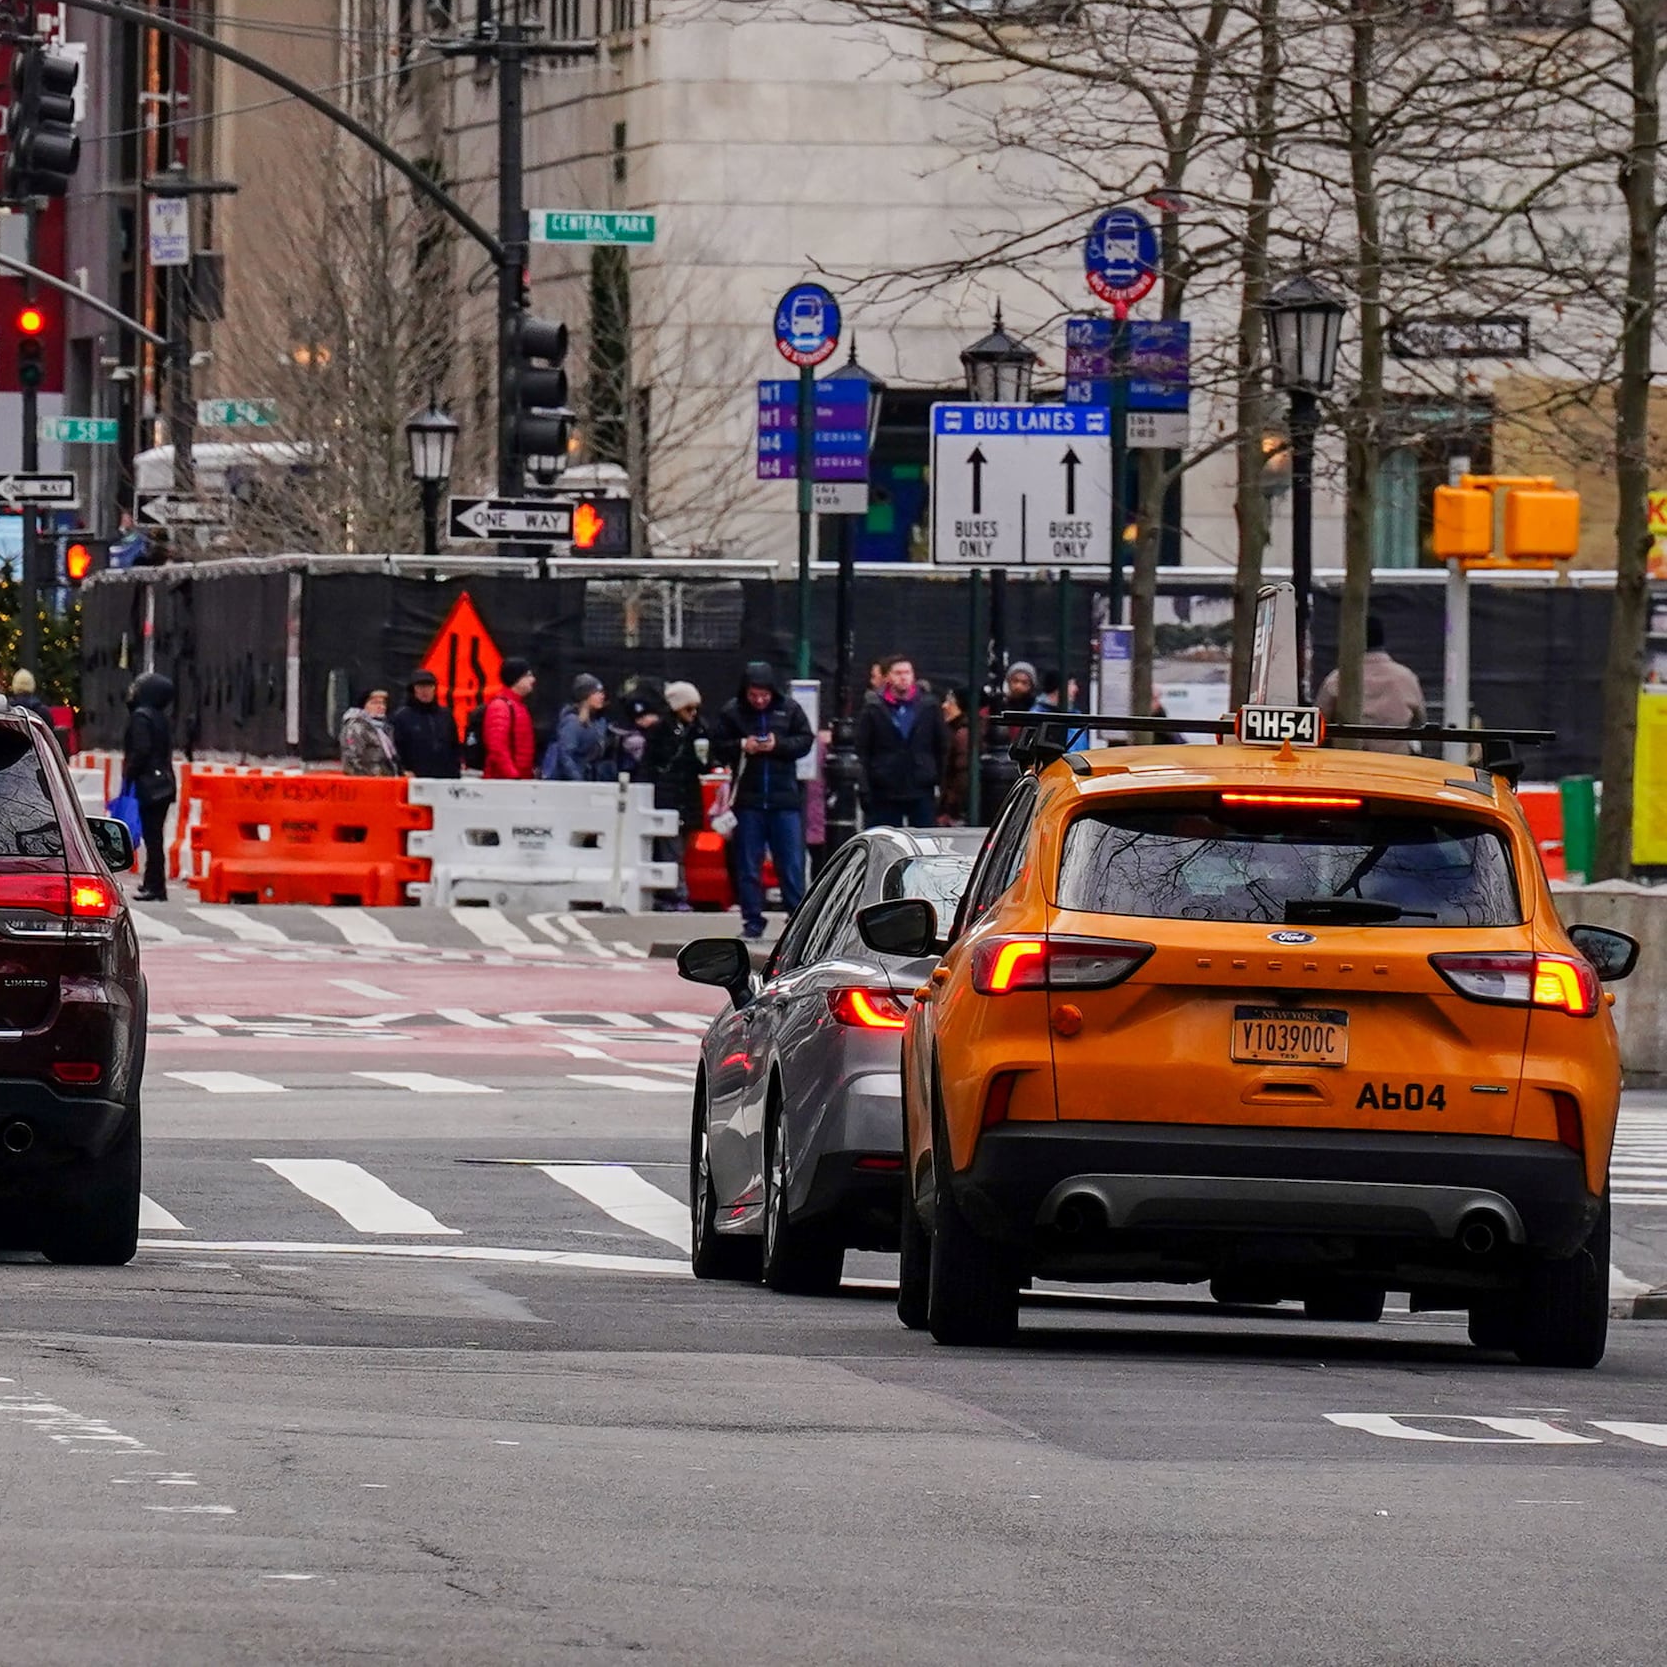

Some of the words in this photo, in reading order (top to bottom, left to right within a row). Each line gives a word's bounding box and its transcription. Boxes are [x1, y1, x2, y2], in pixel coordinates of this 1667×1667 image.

[551, 214, 606, 232] CENTRAL
[615, 216, 649, 233] PARK
[77, 421, 99, 439] 58
[974, 412, 1010, 431] BUS
[1017, 413, 1076, 431] LANES
[474, 511, 507, 528] ONE
[524, 513, 561, 529] WAY
[954, 520, 999, 538] BUSES
[1049, 521, 1092, 539] BUSES
[959, 541, 993, 557] ONLY
[1053, 542, 1087, 558] ONLY
[1246, 712, 1313, 739] 9H54
[1278, 931, 1306, 942] Ford
[1197, 957, 1389, 975] ESCAPE
[4, 979, 49, 988] LIMITED
[1262, 1011, 1296, 1020] NEW
[1297, 1012, 1320, 1022] YORK
[1243, 1021, 1336, 1053] Y103900C
[1355, 1082, 1447, 1111] Ab04
